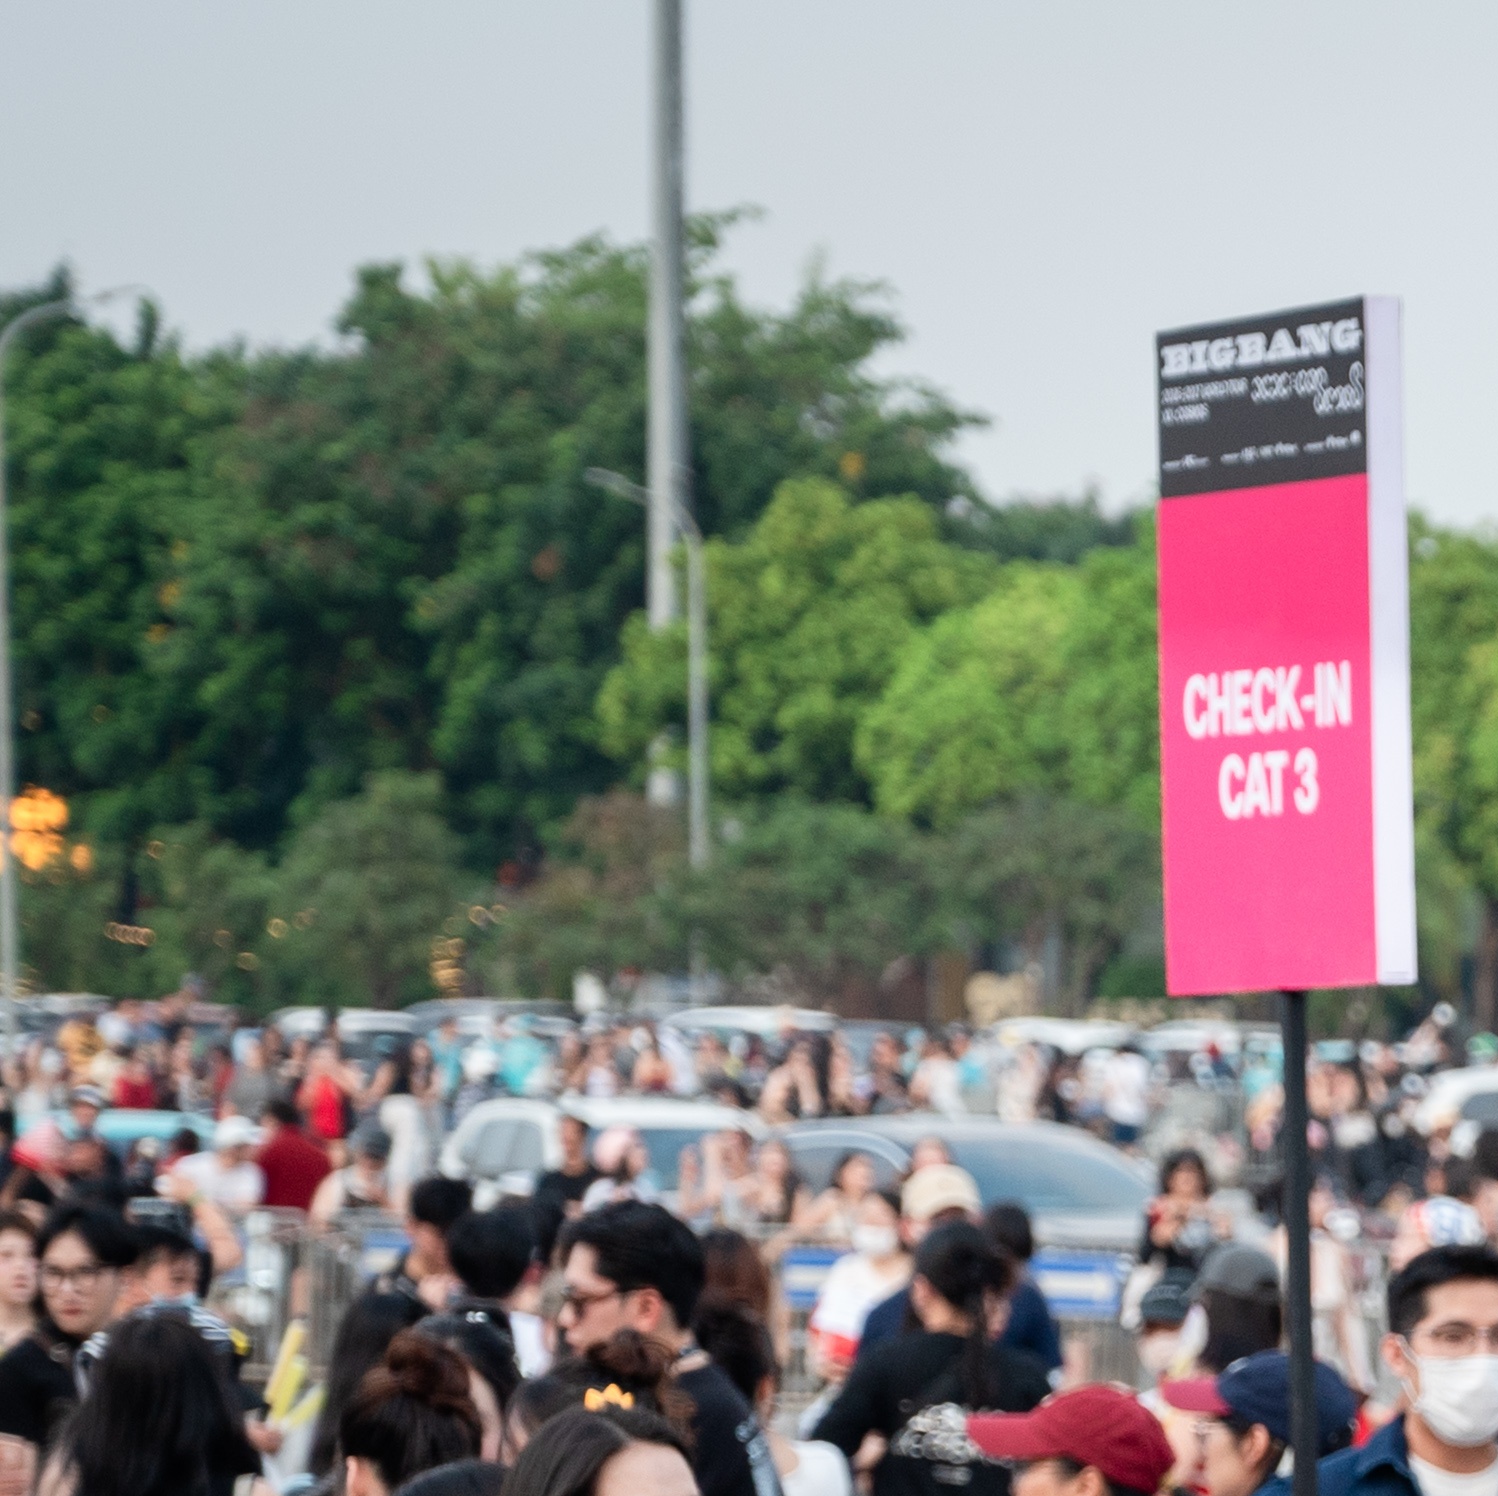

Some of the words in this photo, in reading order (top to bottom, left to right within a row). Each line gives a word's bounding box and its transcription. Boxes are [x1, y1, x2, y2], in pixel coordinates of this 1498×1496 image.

[1160, 317, 1363, 379] BIGBANG
[1182, 659, 1352, 740] CHECK-IN
[1218, 751, 1289, 821] CAT
[1292, 747, 1320, 815] 3
